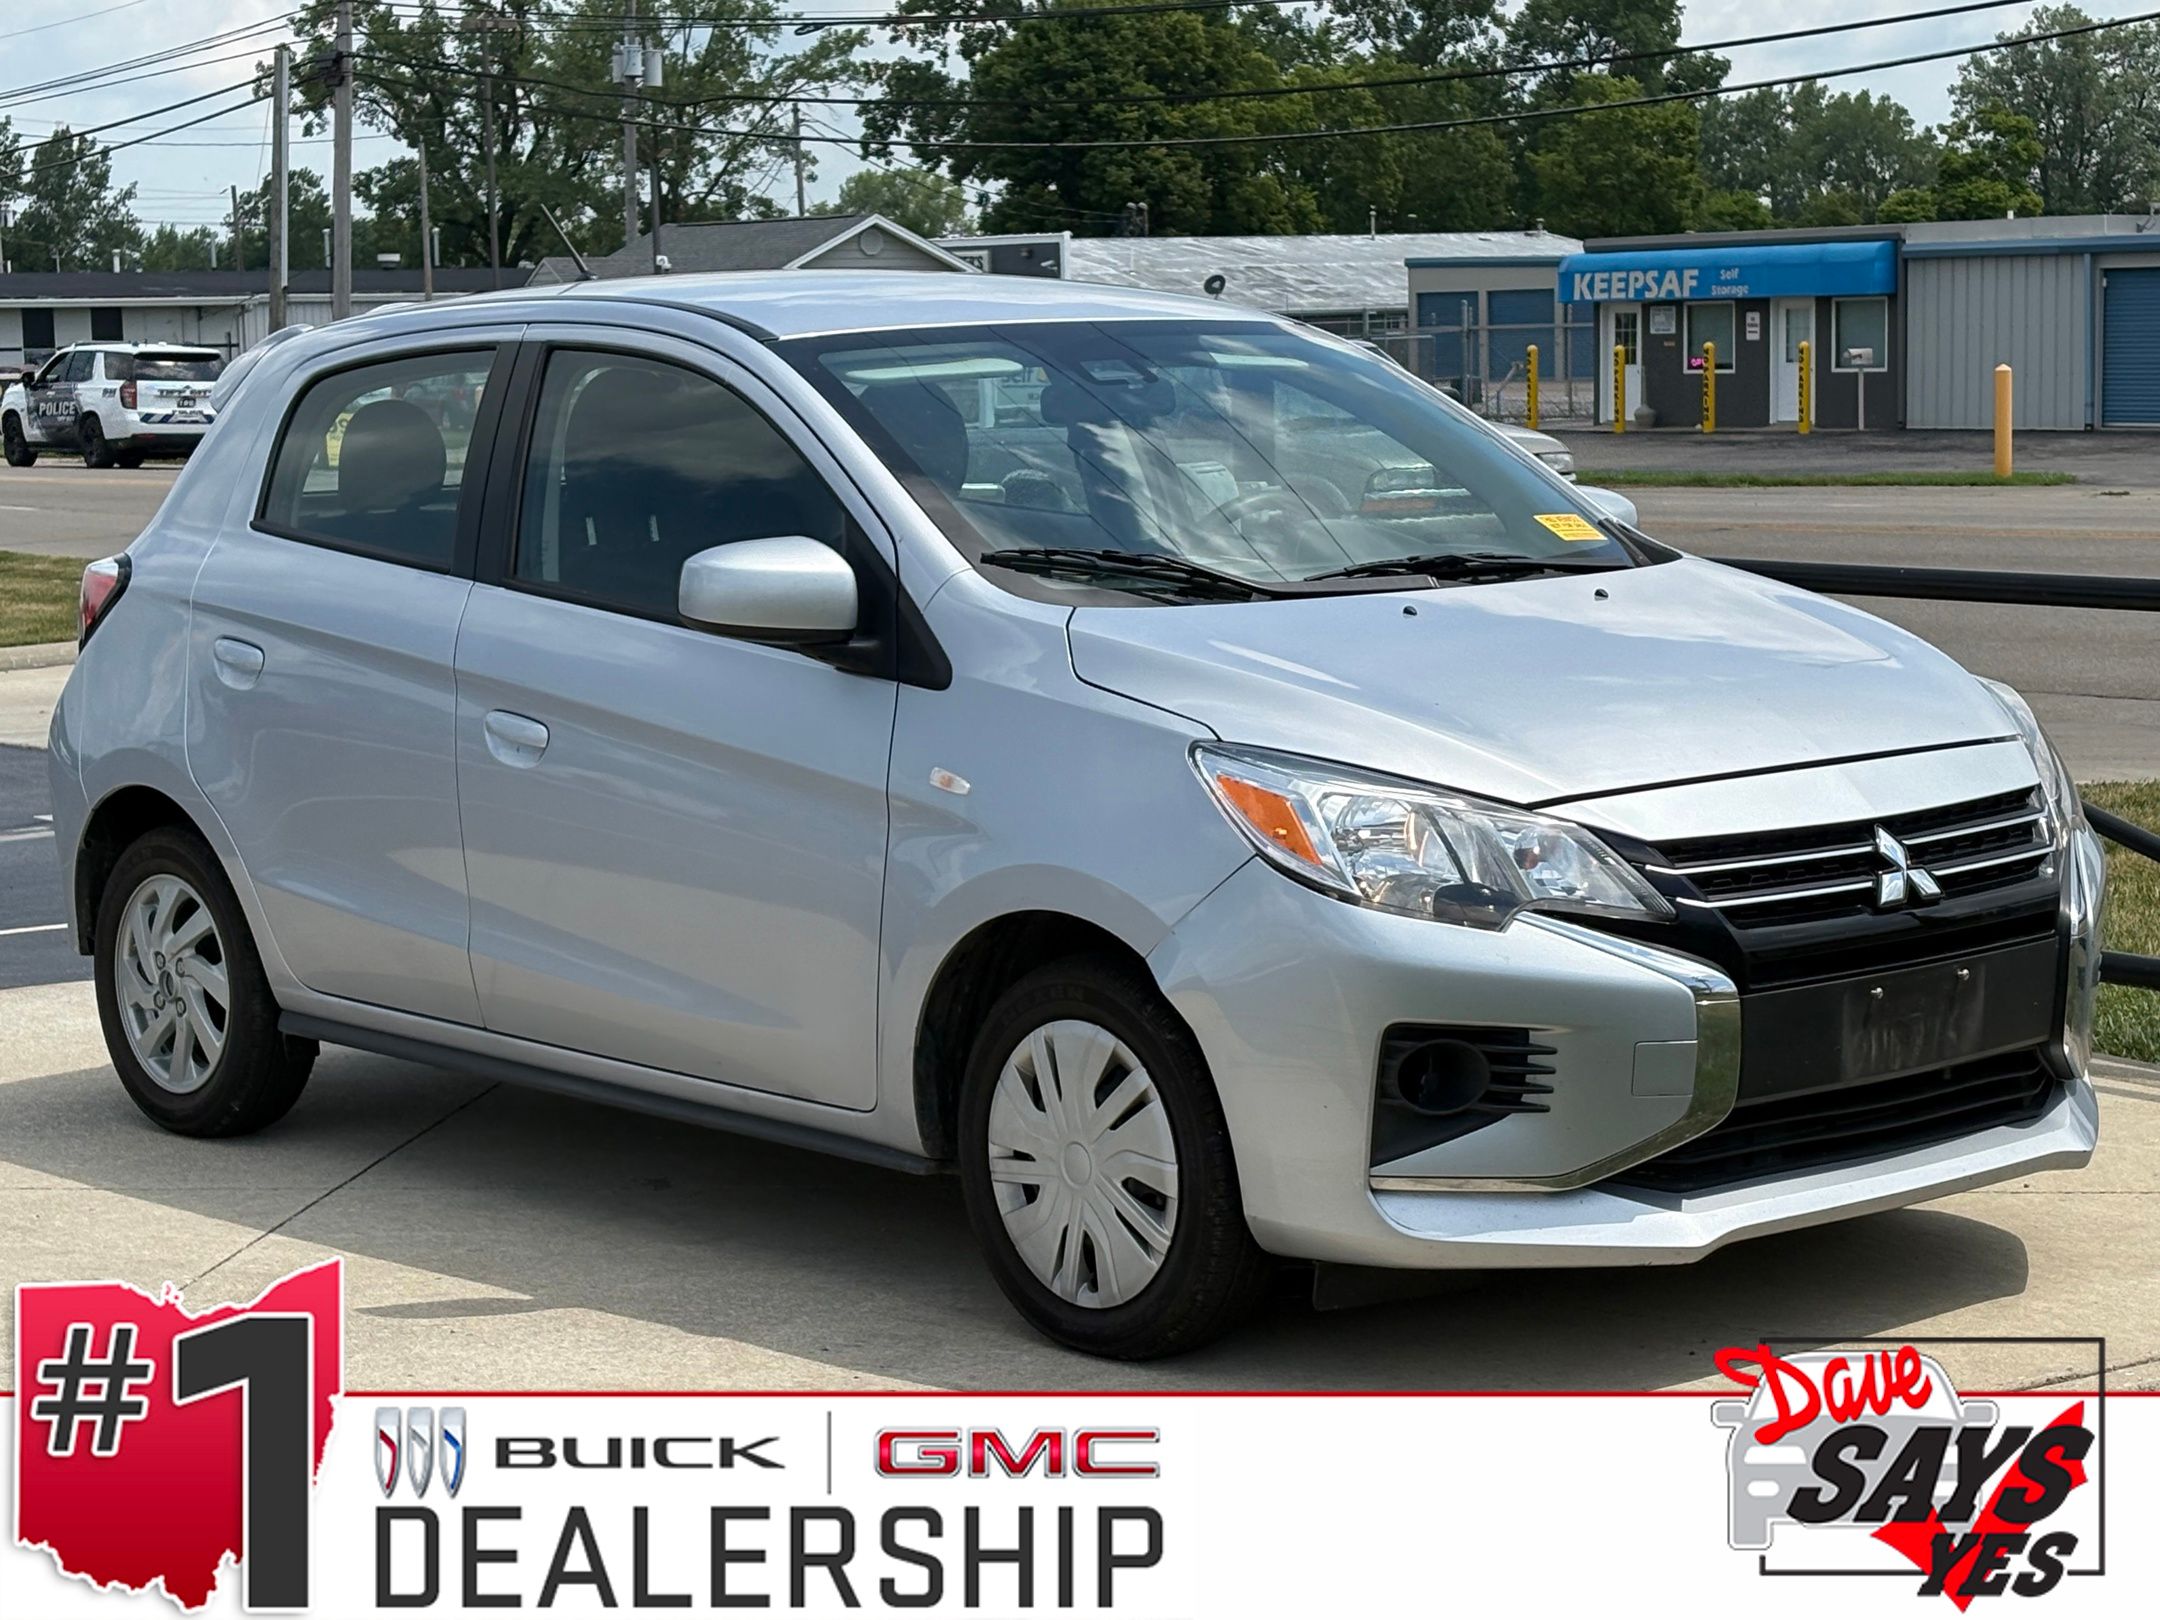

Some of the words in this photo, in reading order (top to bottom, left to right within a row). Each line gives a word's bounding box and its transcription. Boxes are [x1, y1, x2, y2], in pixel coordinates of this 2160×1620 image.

[1720, 268, 1739, 280] Self
[1573, 268, 1699, 301] KEEPSAF
[1711, 284, 1749, 297] Storage
[38, 401, 77, 417] POLICE
